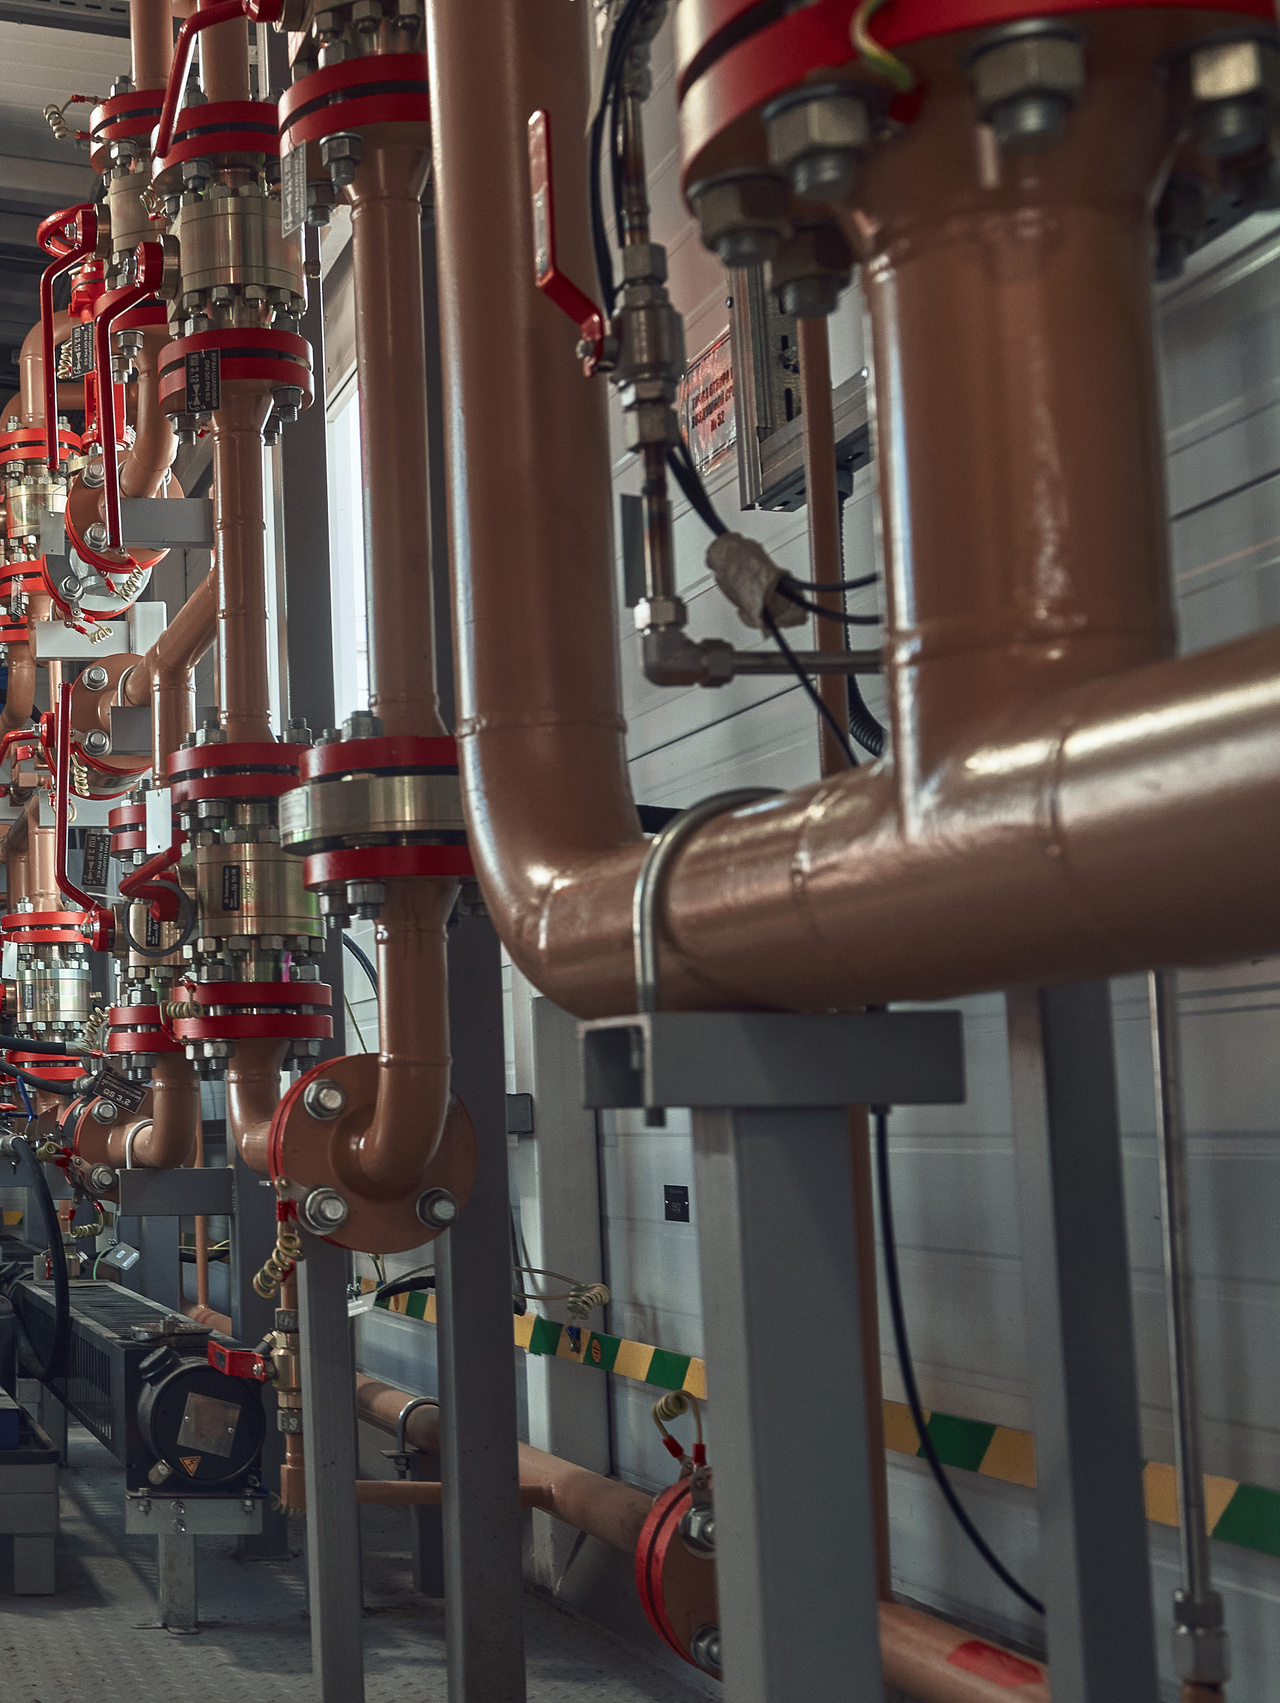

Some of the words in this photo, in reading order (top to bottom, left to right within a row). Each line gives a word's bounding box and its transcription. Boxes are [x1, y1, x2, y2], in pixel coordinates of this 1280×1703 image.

[190, 354, 199, 366] КШ
[205, 360, 210, 370] DN
[190, 367, 199, 384] 3.12
[205, 371, 210, 381] 50
[205, 381, 210, 391] PN
[211, 372, 219, 408] ШАРОВОЙ
[205, 392, 211, 402] 63
[717, 410, 725, 427] 52
[87, 836, 97, 848] КШ
[100, 854, 108, 884] ШАРОВОЙ
[116, 1094, 131, 1106] 3.2
